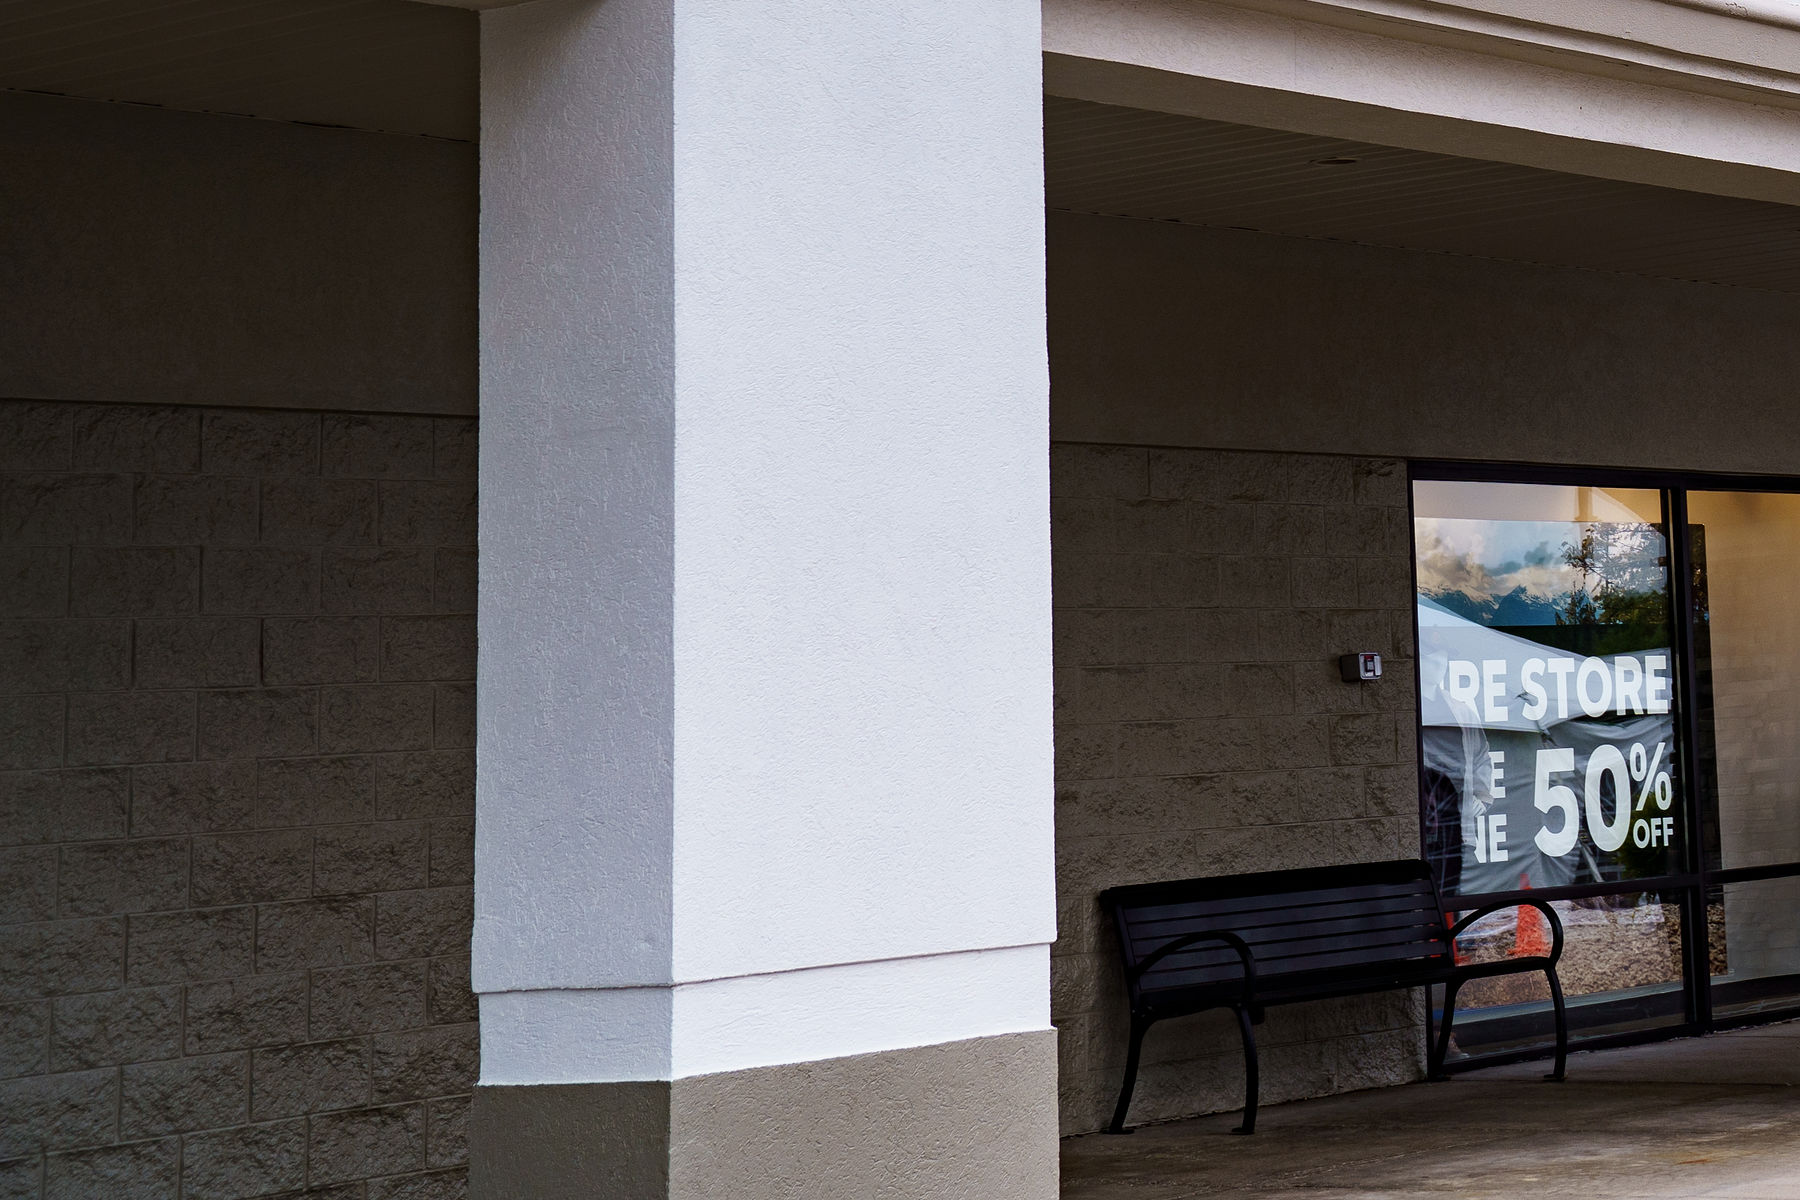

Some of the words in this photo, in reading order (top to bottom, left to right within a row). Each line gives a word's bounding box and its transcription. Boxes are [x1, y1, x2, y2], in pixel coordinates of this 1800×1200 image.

[1440, 660, 1508, 722] RE
[1521, 656, 1669, 721] STORE
[1534, 742, 1673, 857] 50%
[1633, 817, 1674, 849] OFF
